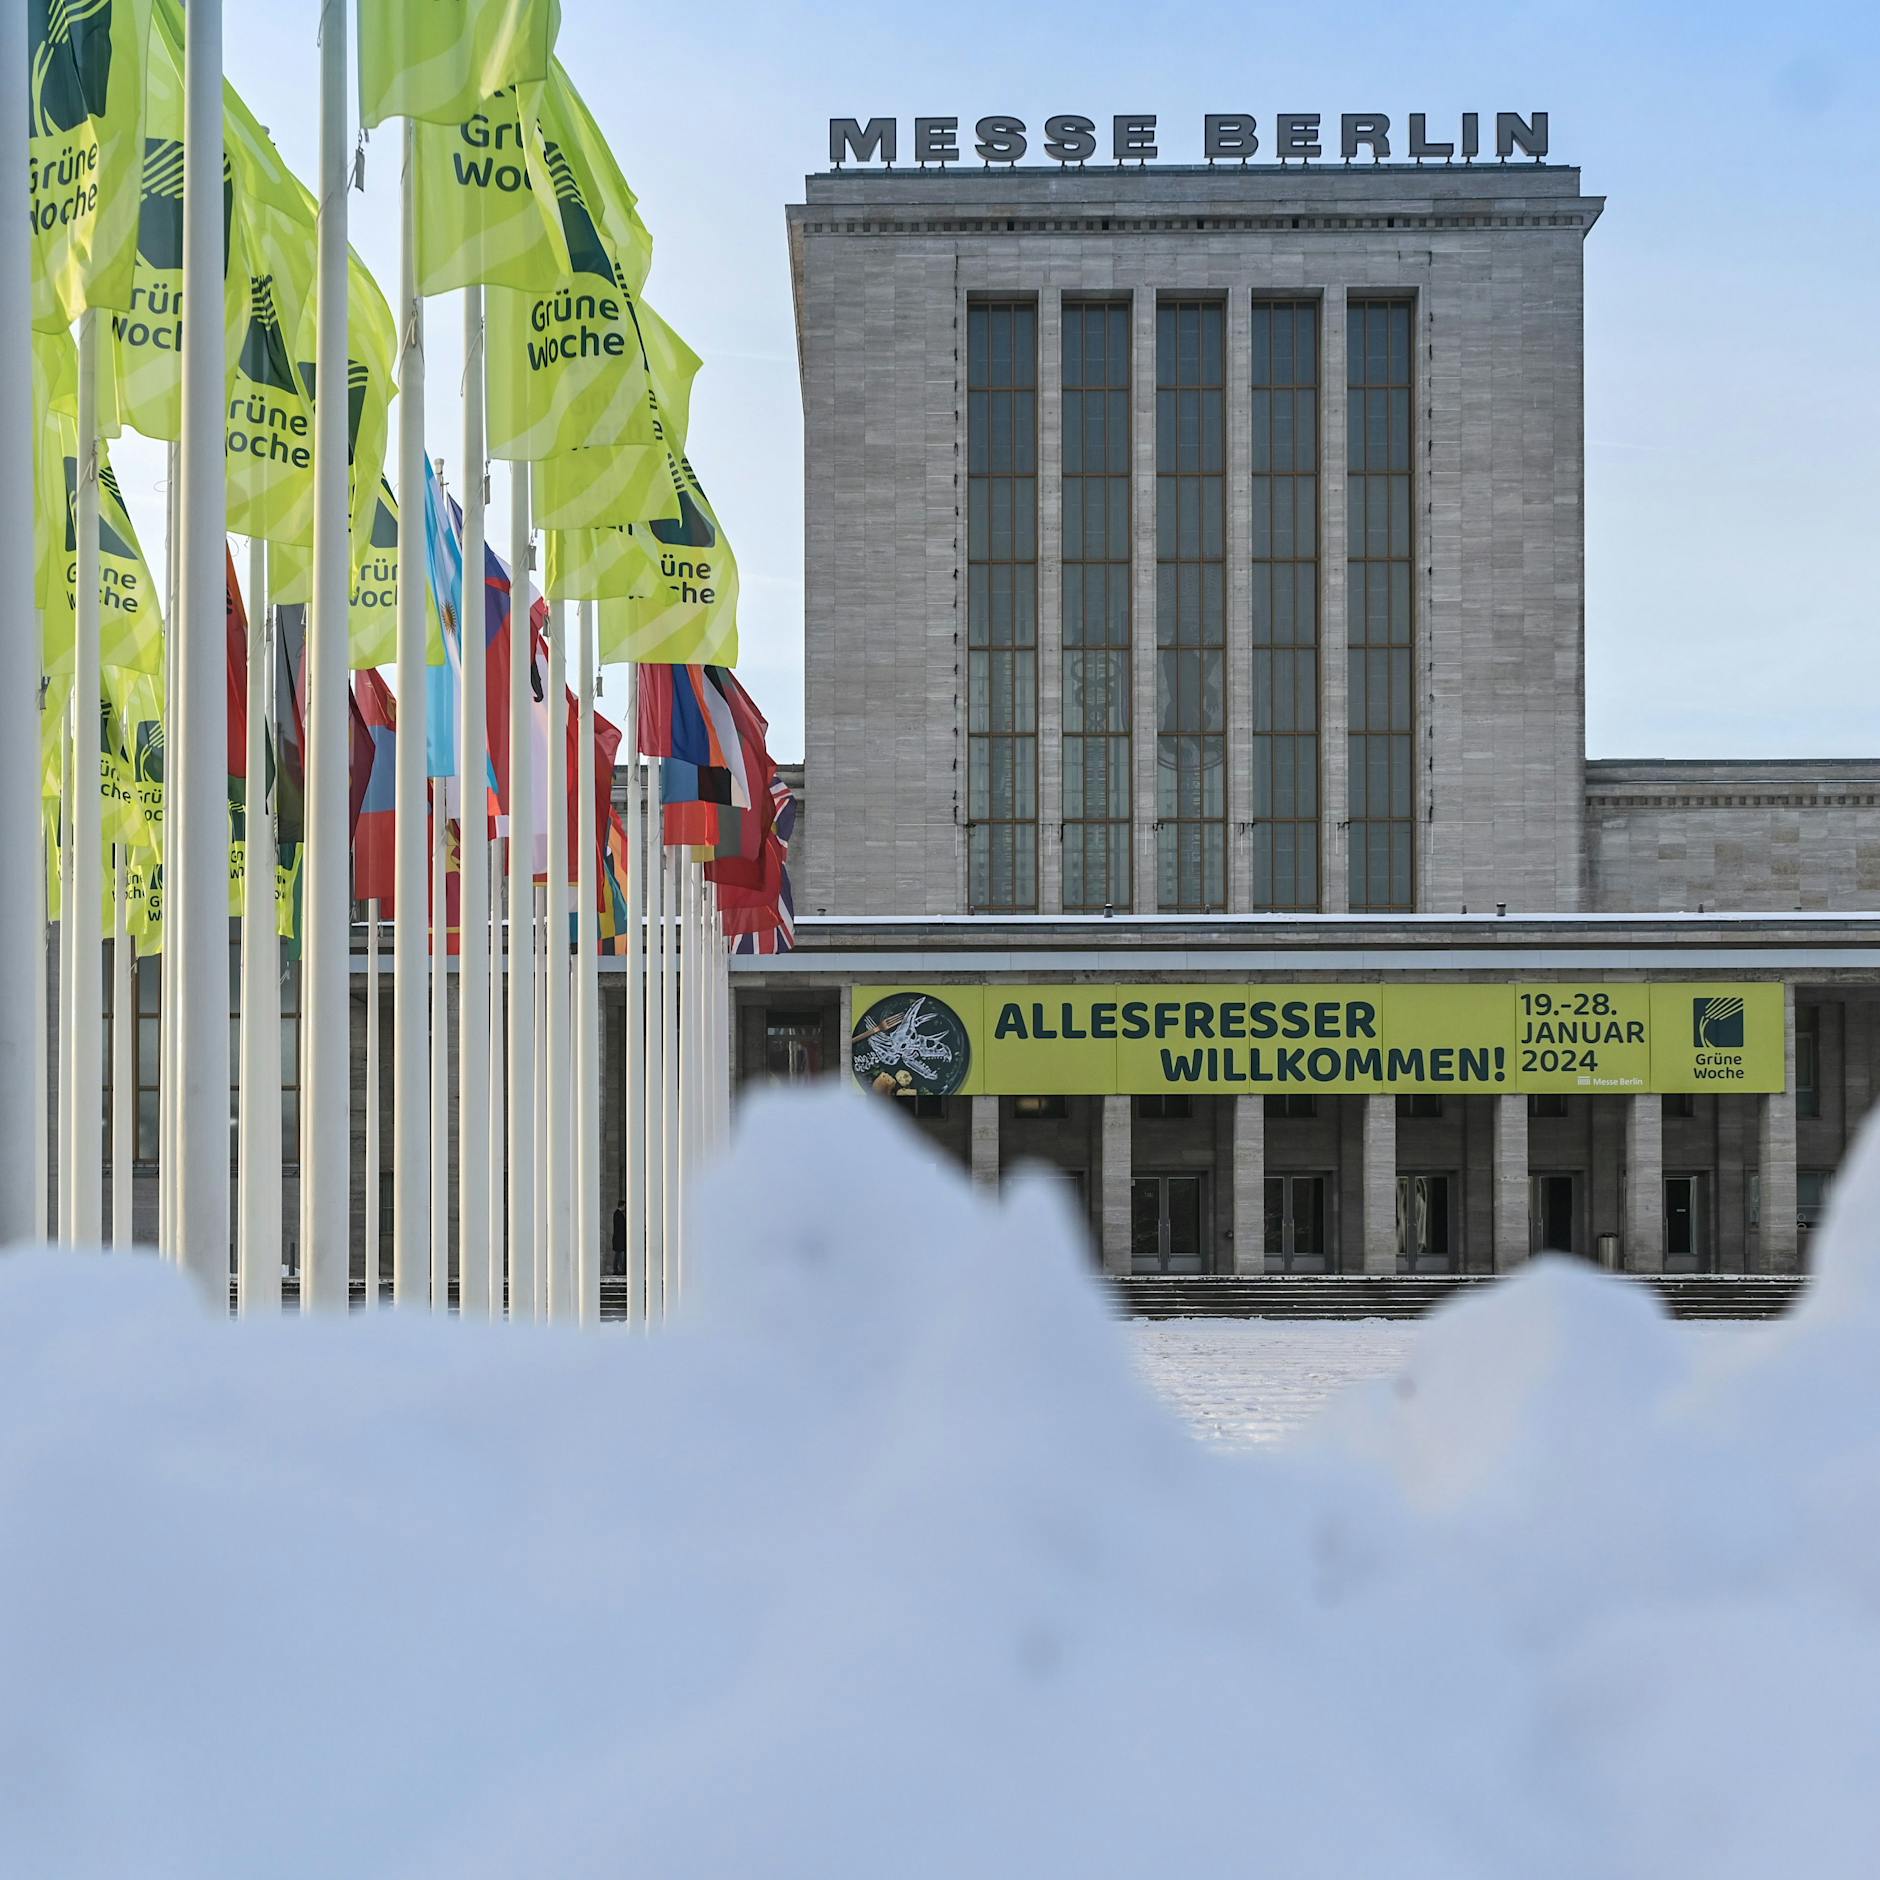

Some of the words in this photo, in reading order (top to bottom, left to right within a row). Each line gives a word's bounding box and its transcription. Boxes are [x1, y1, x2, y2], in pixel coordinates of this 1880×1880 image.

[830, 114, 1158, 162] MESSE
[1204, 112, 1548, 158] BERLIN
[531, 288, 620, 333] Grüne
[527, 325, 625, 371] Woche
[230, 394, 308, 437] rüne
[225, 426, 311, 469] oche
[994, 1001, 1377, 1040] ALLESFRESSER
[1520, 992, 1617, 1016] 19.-28.
[1520, 1020, 1646, 1044] JANUAR
[1160, 1046, 1506, 1083] WILLKOMMEN!
[1521, 1049, 1599, 1073] 2024
[1693, 1066, 1745, 1079] Woche
[1695, 1053, 1742, 1066] Grüne
[1592, 1077, 1618, 1086] Messe
[1619, 1077, 1643, 1086] Berlin
